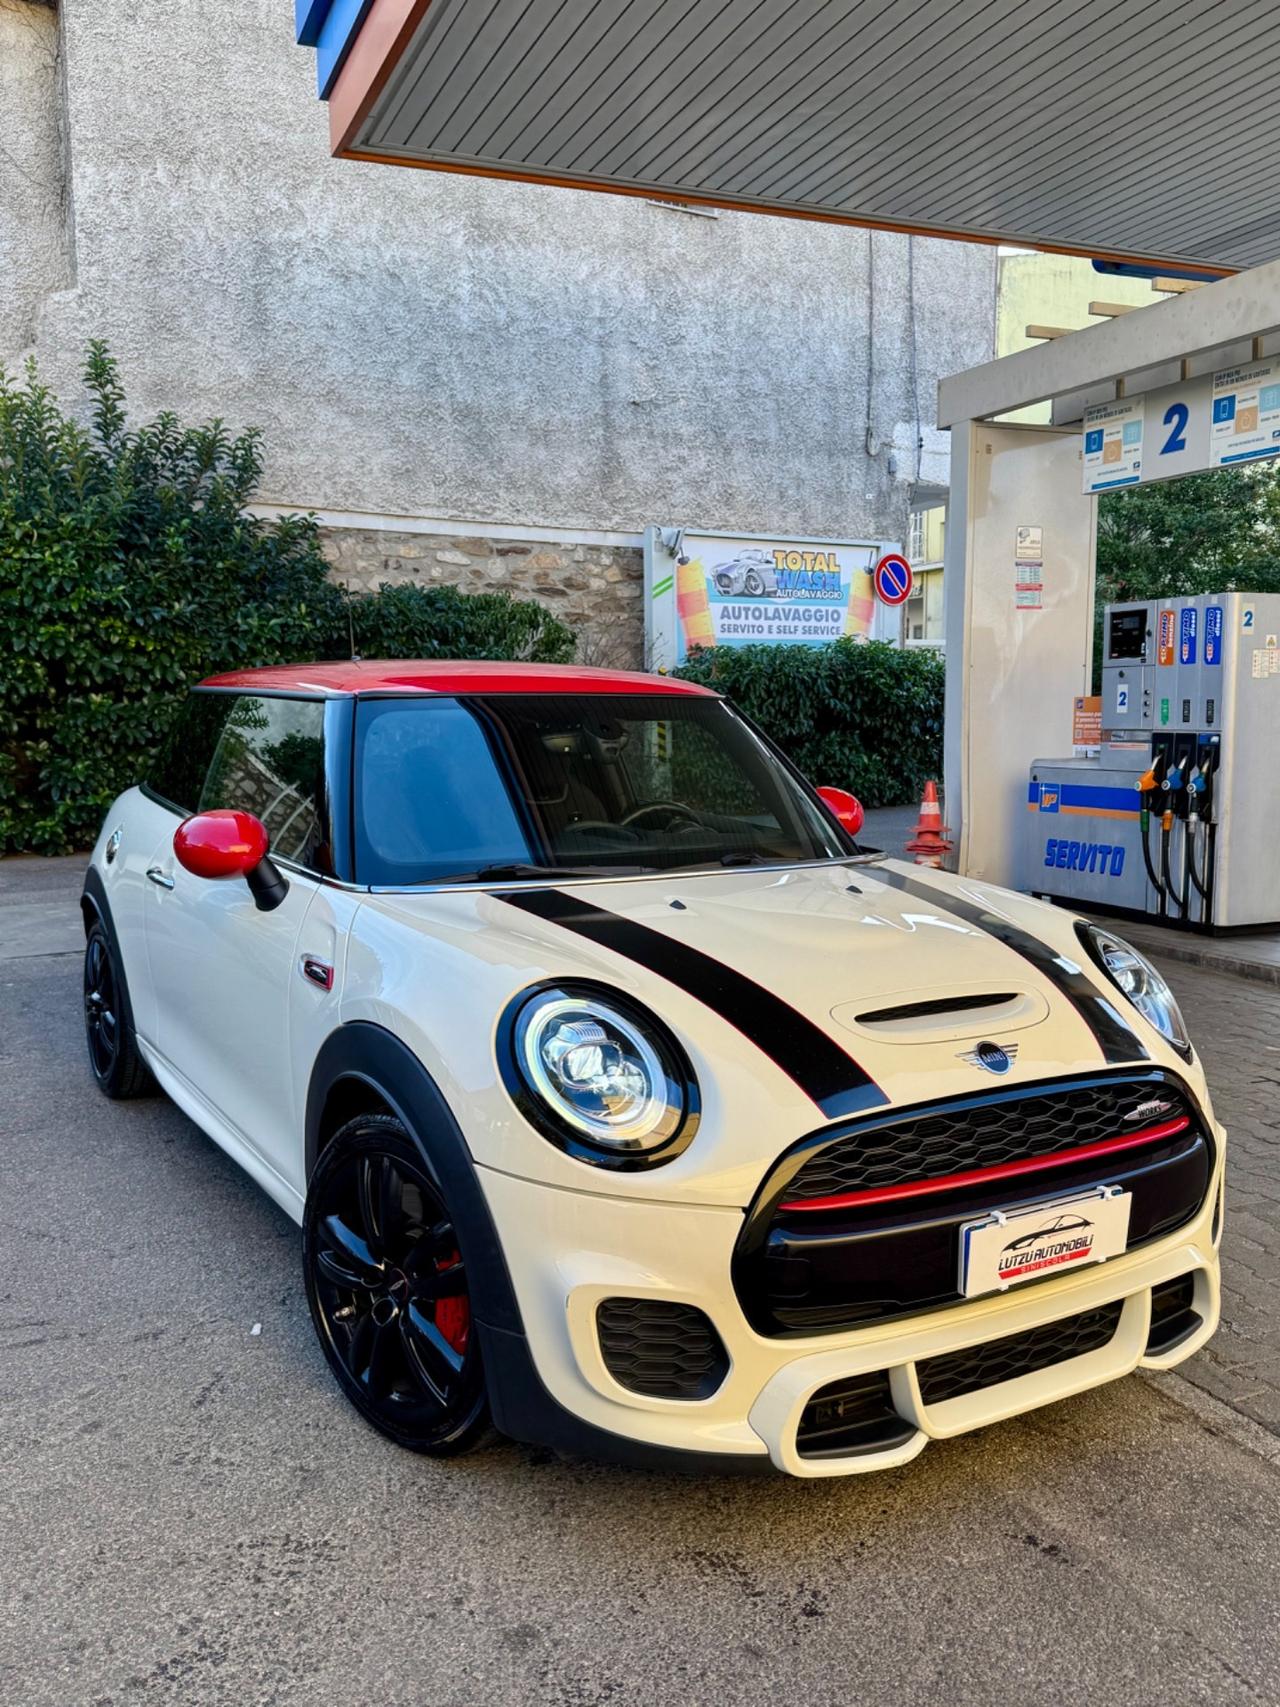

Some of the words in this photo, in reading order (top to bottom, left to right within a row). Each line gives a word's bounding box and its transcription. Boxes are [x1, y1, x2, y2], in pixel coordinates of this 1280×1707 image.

[1159, 403, 1189, 456] 2
[773, 549, 841, 573] TOTAL
[774, 569, 841, 591] WASH
[776, 588, 843, 600] AUTOLAVAGGIO
[720, 605, 841, 623] AUTOLAVAGGIO
[1243, 610, 1254, 627] 2
[720, 623, 764, 634] SERVITO
[768, 624, 774, 634] E
[776, 625, 799, 635] SELF
[801, 625, 840, 636] SERVICE
[1118, 691, 1127, 706] 2
[1044, 838, 1126, 877] SERVITO
[981, 1051, 1006, 1064] MINI
[1137, 1105, 1162, 1119] WORKS
[998, 1250, 1034, 1271] LUTZU
[1033, 1234, 1095, 1261] AUTOMOBILI
